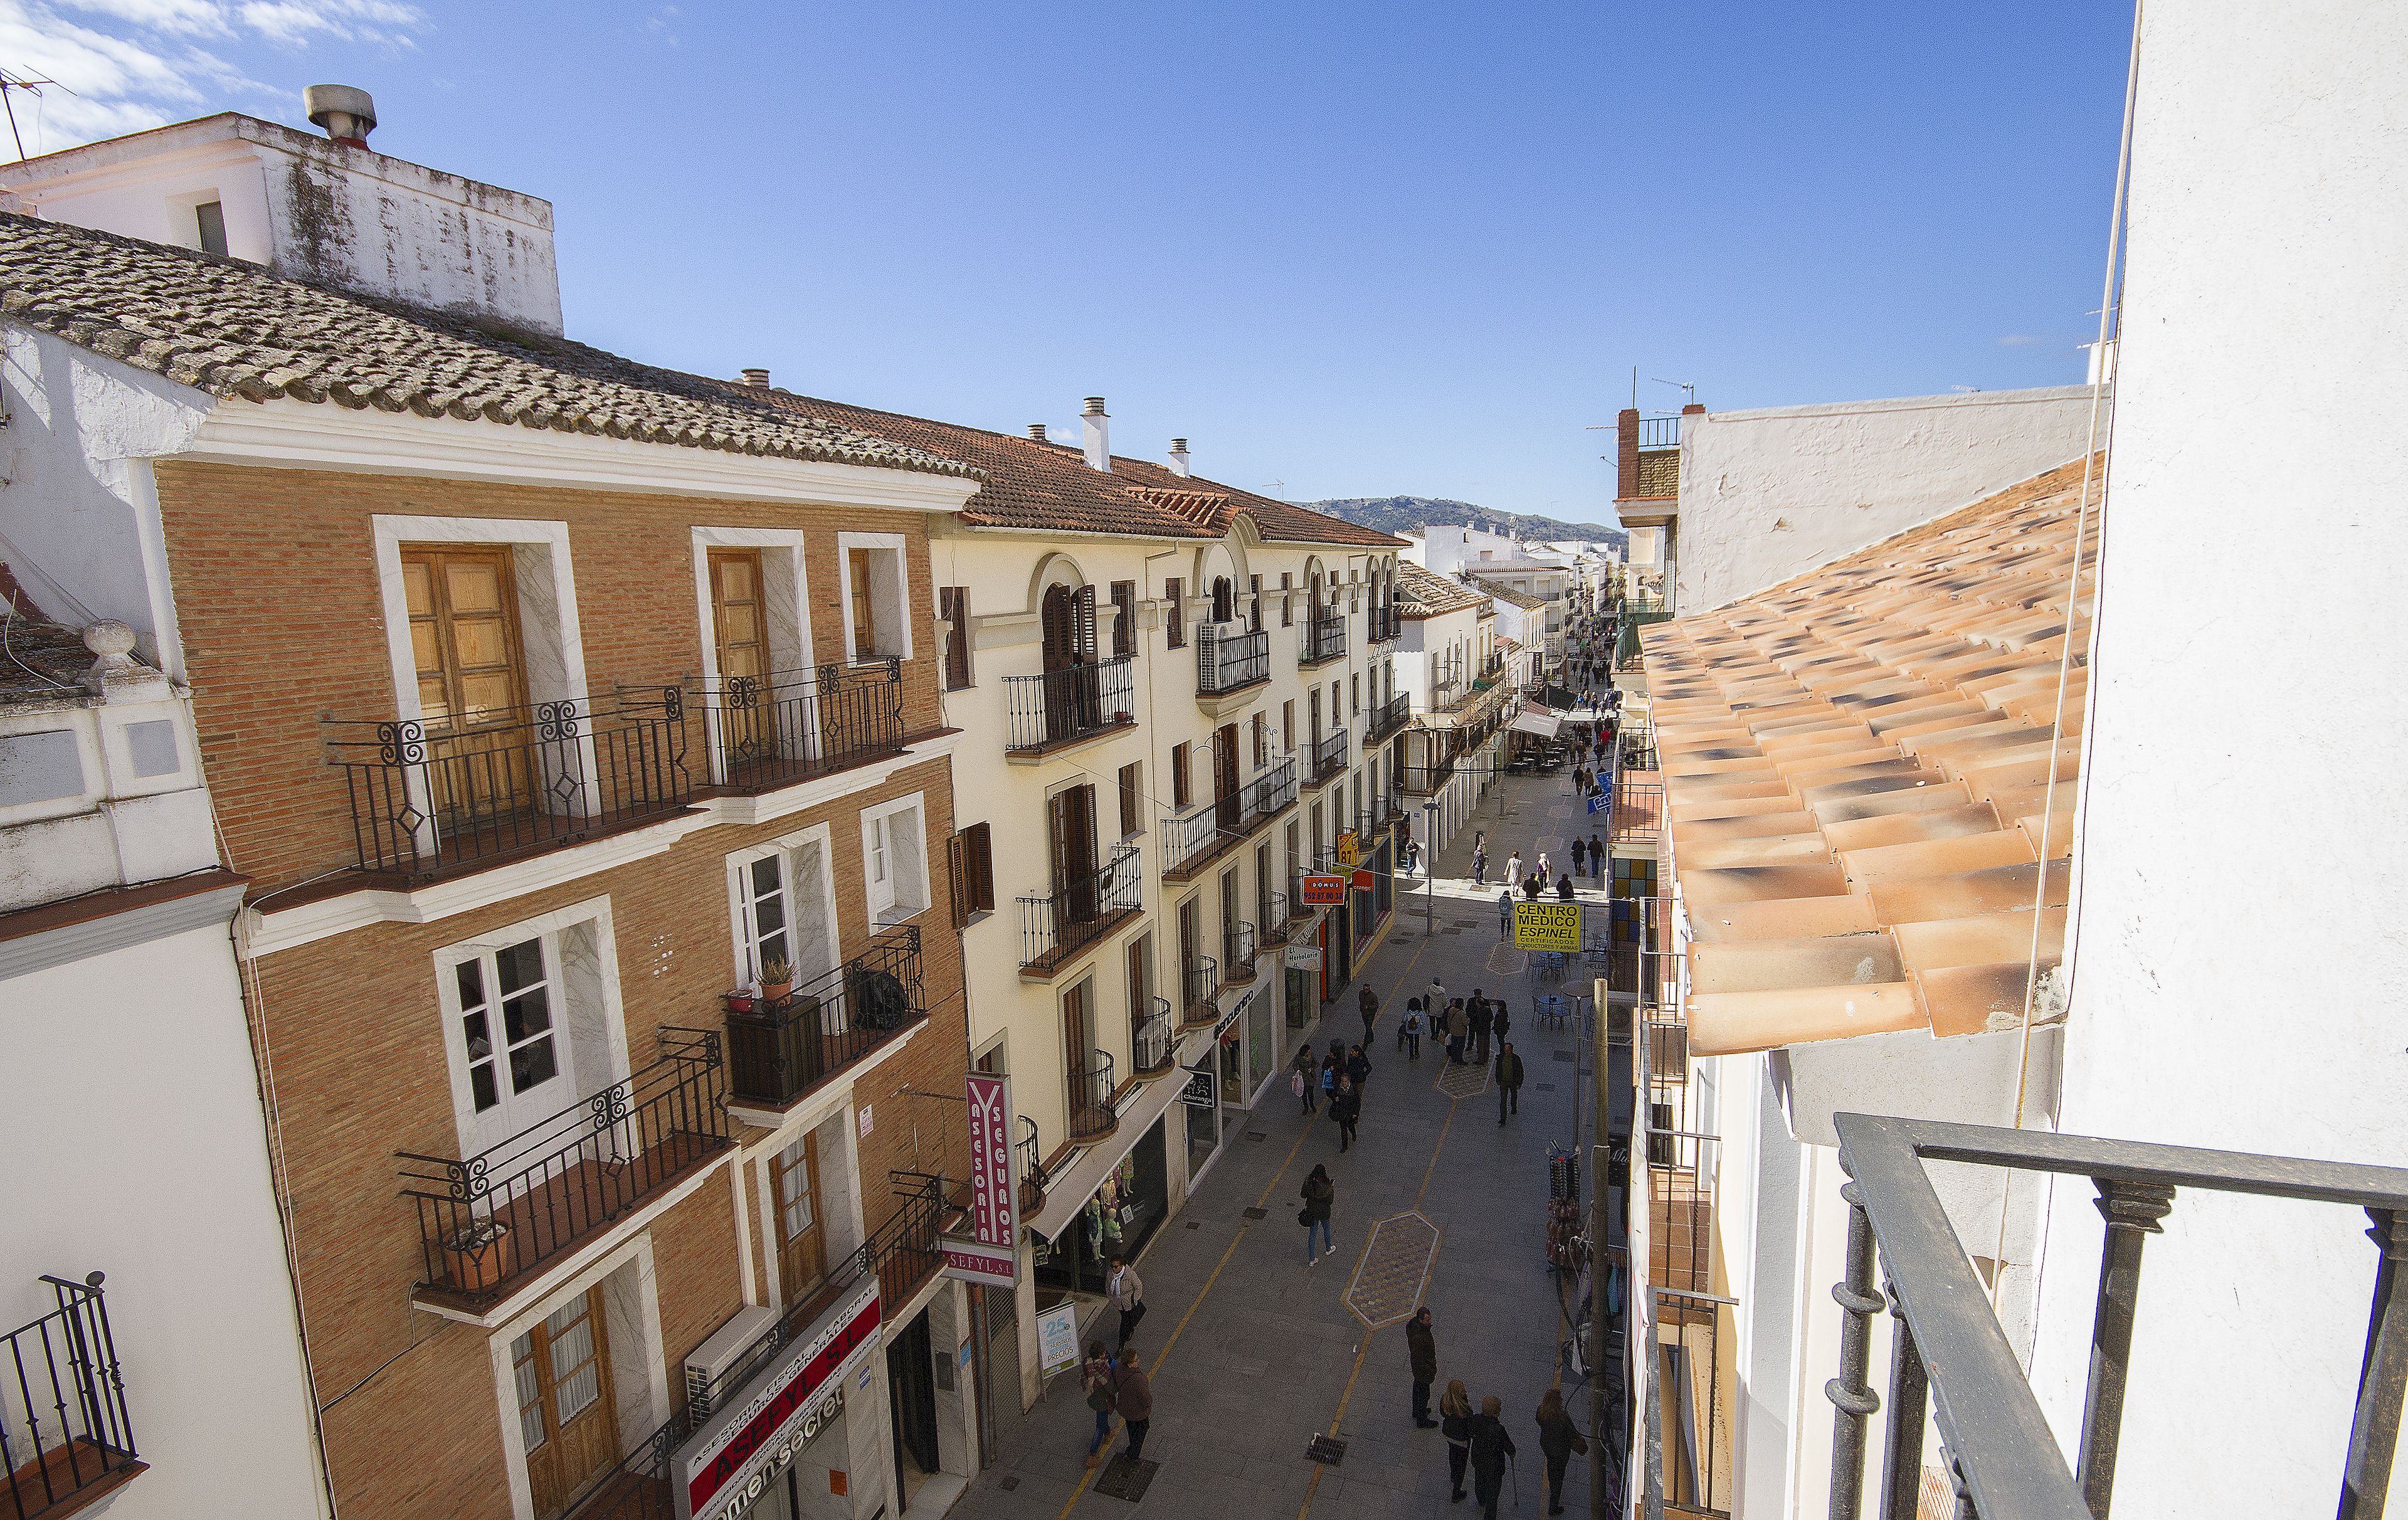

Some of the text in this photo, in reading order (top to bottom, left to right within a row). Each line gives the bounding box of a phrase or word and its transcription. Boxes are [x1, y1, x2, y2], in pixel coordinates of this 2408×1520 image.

[1341, 850, 1352, 864] 87
[1517, 904, 1577, 916] CENTRO
[1518, 915, 1576, 927] MEDICO
[1519, 927, 1575, 939] ESPINEL
[1289, 952, 1318, 961] Herbolario
[1183, 1094, 1212, 1104] Charanga
[971, 1103, 989, 1242] ASESORIA
[993, 1106, 1010, 1245] SEGUROS
[1047, 1346, 1074, 1363] PRECIOS
[693, 1399, 760, 1467] ASESORIA
[766, 1353, 808, 1395] FISCAL
[813, 1337, 820, 1346] Y
[825, 1287, 875, 1336] LABORAL
[722, 1313, 854, 1446] SEGUROS GENERALES
[714, 1327, 865, 1488] ASEFYL S.L.
[754, 1432, 785, 1465] SOCIAL
[793, 1386, 830, 1423] GENERAL
[847, 1334, 878, 1367] AGRARIA
[746, 1417, 794, 1468] PENSIONES
